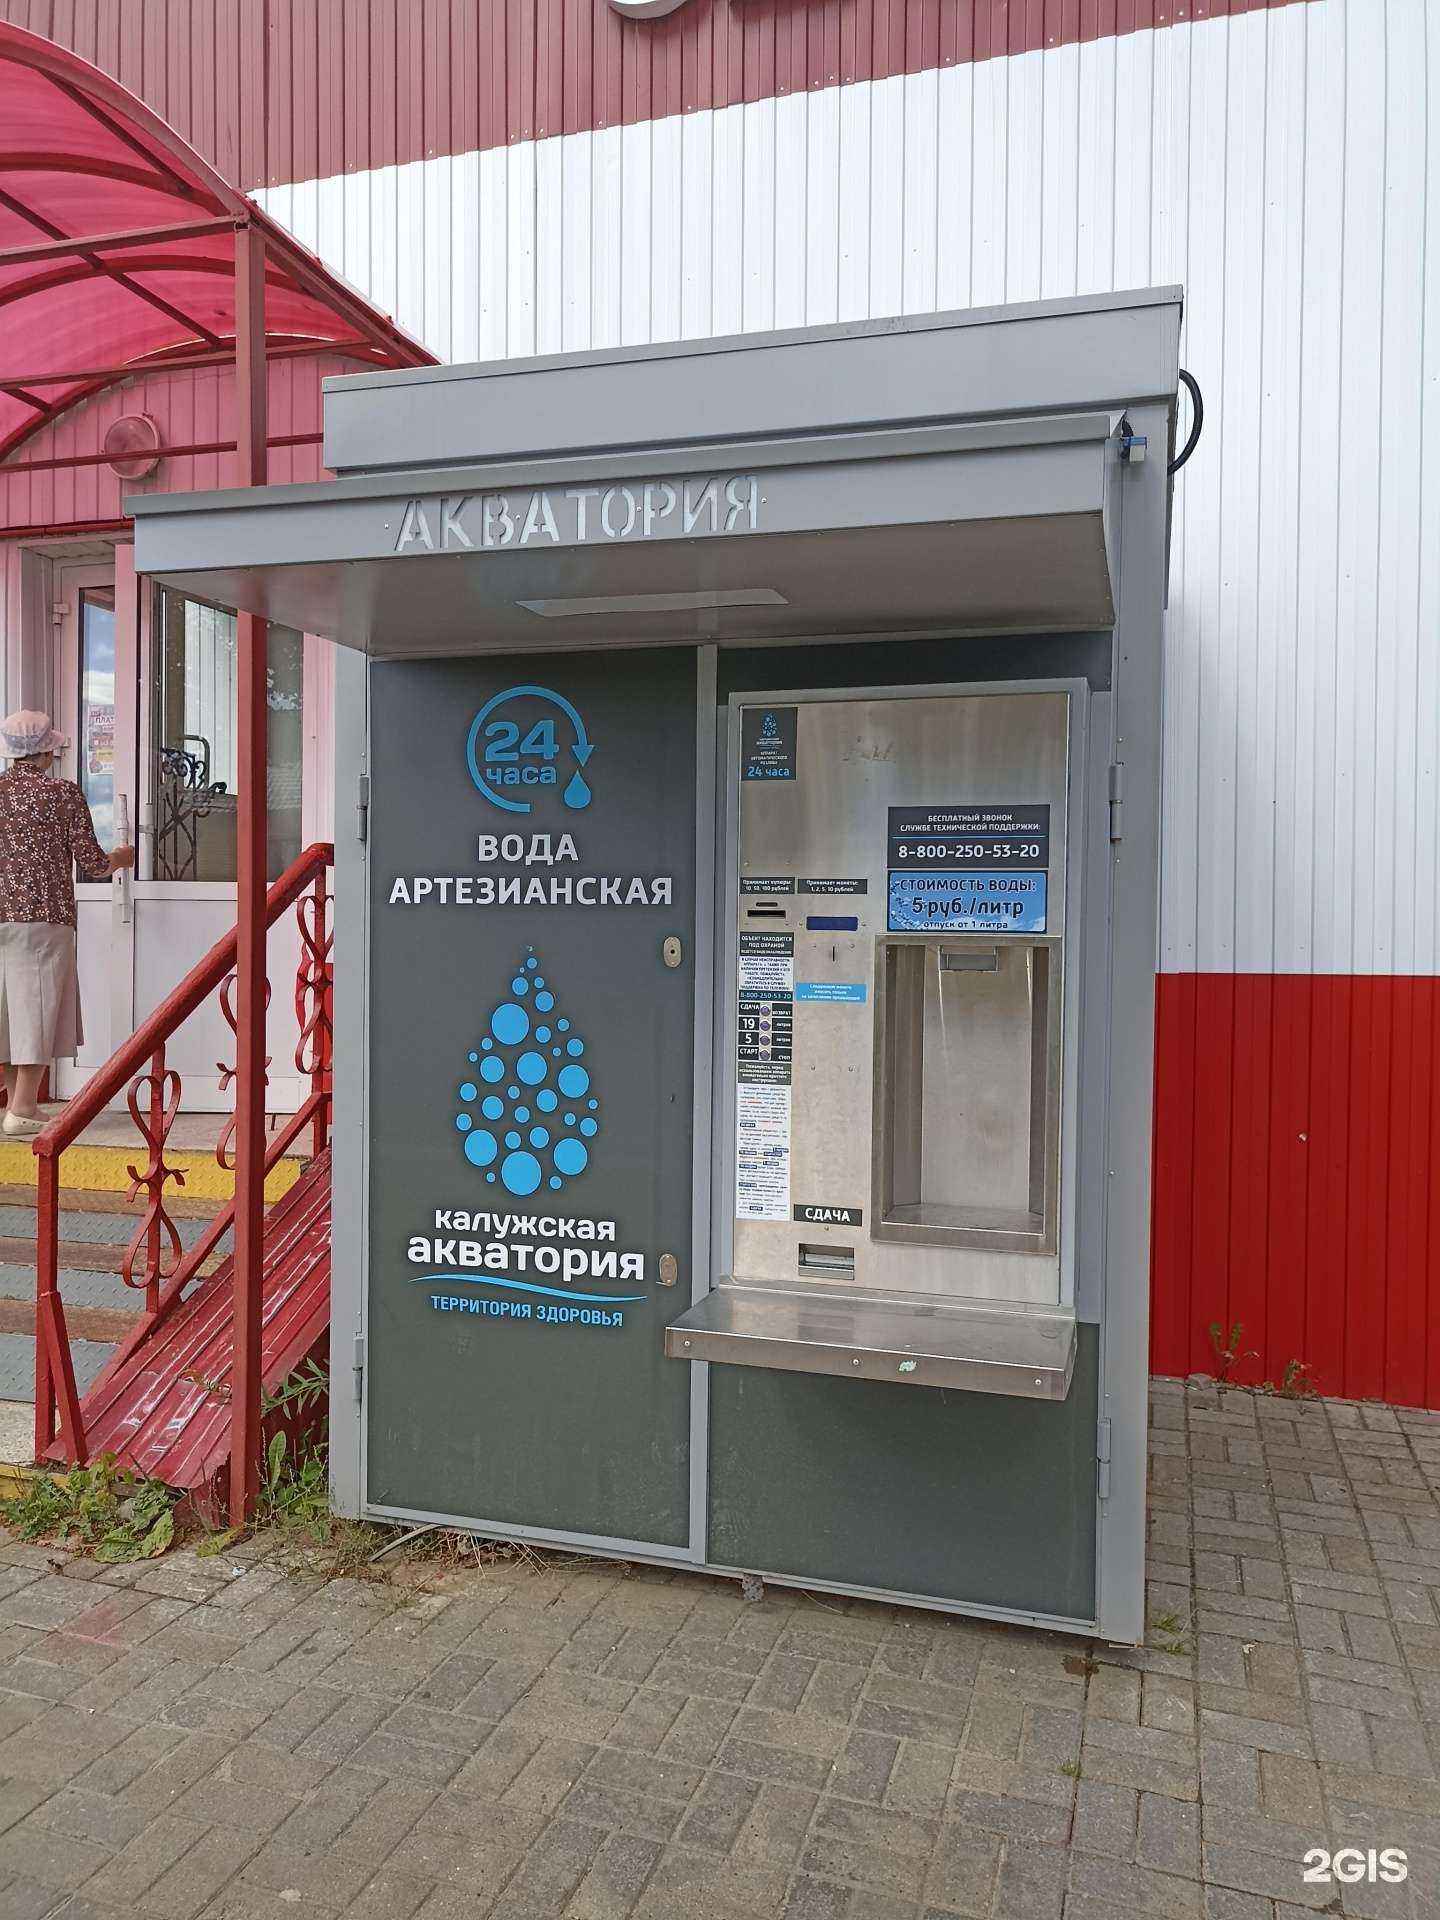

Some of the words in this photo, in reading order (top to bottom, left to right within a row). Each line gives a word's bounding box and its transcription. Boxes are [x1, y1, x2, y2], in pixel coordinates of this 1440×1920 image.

[394, 474, 759, 551] АКВАТОРИЯ
[485, 719, 560, 762] 24
[486, 764, 558, 785] часа
[747, 766, 763, 777] 24
[766, 768, 790, 777] часа
[928, 813, 980, 822] БЕСПЛАТНЫЙ
[982, 814, 1013, 822] ЗВОНОК
[900, 824, 931, 832] СЛУЖБЕ
[933, 823, 988, 832] ТЕХНИЧЕСКОЙ
[989, 823, 1041, 832] ПОДДЕРЖКИ:
[478, 833, 579, 866] ВОДА
[898, 844, 1040, 858] 8-800-250-53-20
[389, 877, 673, 905] АРТЕЗИАНСКАЯ
[900, 879, 985, 891] СТОИМОСТЬ
[989, 879, 1037, 893] ВОДЫ:
[912, 897, 923, 914] 5
[923, 921, 955, 929] отпуск
[957, 921, 968, 929] от
[971, 920, 976, 928] 1
[979, 921, 1008, 929] литра
[742, 1018, 755, 1029] 19
[745, 1033, 752, 1044] 5
[805, 1207, 851, 1222] СДАЧА
[434, 1208, 616, 1241] калужская
[407, 1235, 645, 1282] акватория
[431, 1295, 532, 1319] ТЕРРИТОРИЯ
[536, 1305, 623, 1327] ЗДОРОВЬЯ
